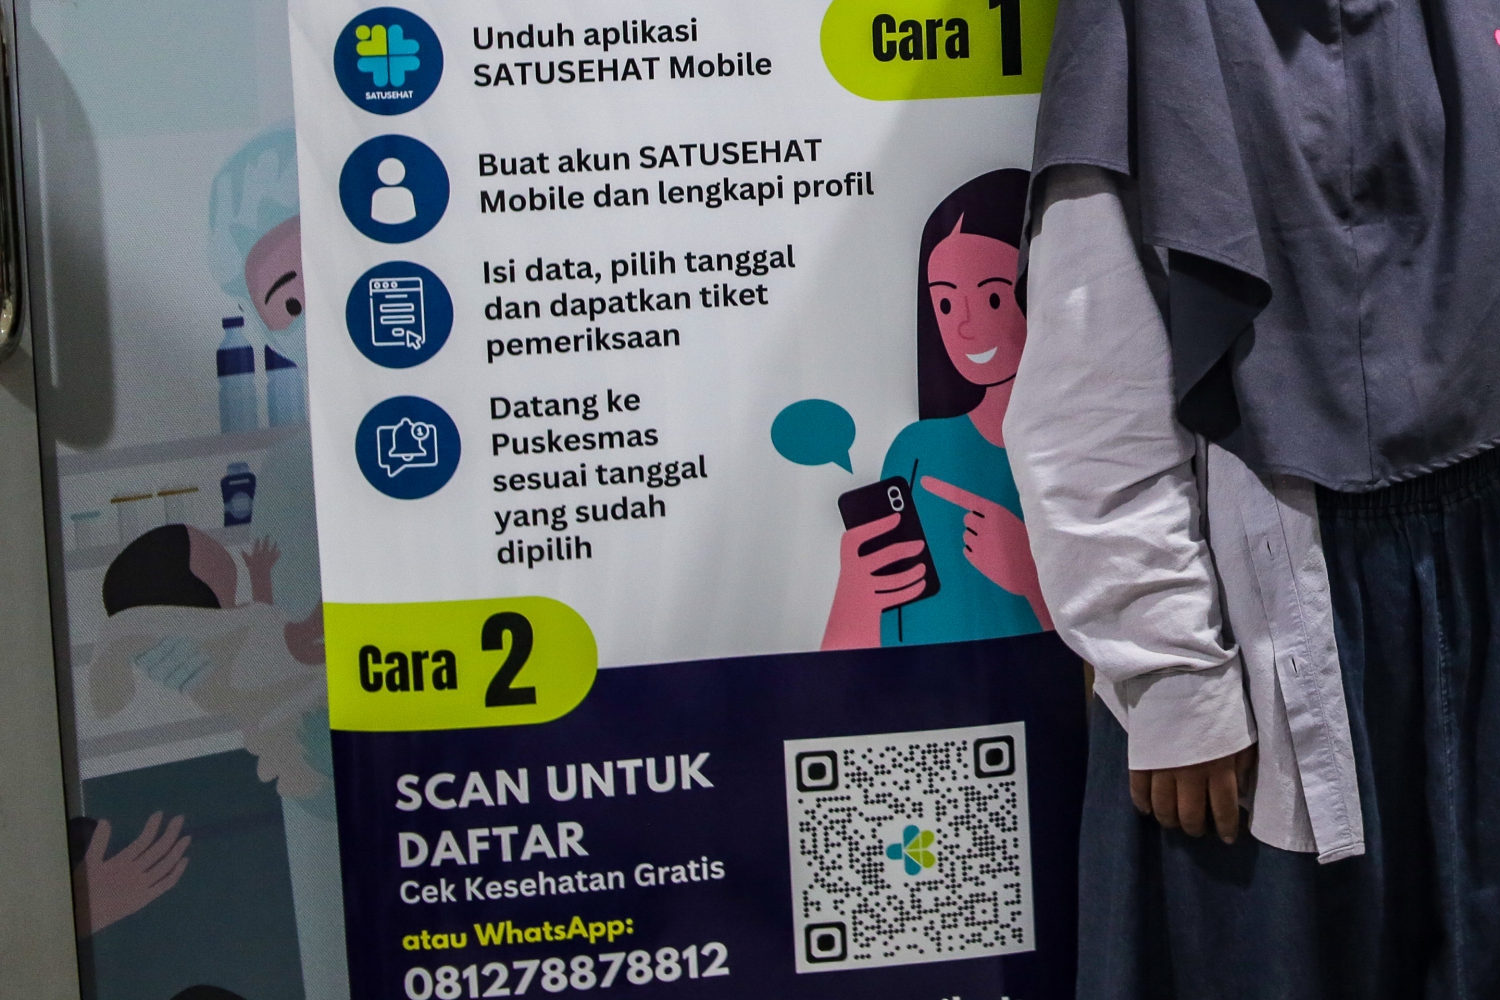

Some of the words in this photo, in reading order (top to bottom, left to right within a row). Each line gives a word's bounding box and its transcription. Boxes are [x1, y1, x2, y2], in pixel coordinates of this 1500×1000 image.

[473, 23, 575, 49] Unduh
[583, 17, 699, 53] aplikasi
[871, 13, 970, 62] Cara
[473, 56, 660, 87] SATUSEHAT
[670, 52, 772, 79] Mobile
[365, 90, 414, 100] SATUSEHAT
[478, 152, 549, 177] Buat
[558, 146, 630, 172] akun
[639, 139, 822, 169] SATUSEHAT
[480, 184, 584, 214] Mobile
[593, 179, 649, 208] dan
[659, 174, 785, 208] lengkapi
[793, 171, 874, 203] profil
[483, 260, 515, 285] Isi
[525, 255, 602, 283] data,
[611, 249, 676, 283] pilih
[684, 245, 795, 280] tanggal
[485, 292, 541, 321] dan
[550, 285, 691, 323] dapatkan
[700, 283, 768, 308] tiket
[487, 325, 680, 363] pemeriksaan
[490, 394, 599, 419] Datang
[608, 390, 640, 413] ke
[492, 426, 658, 456] Puskesmas
[493, 463, 587, 492] sesuai
[595, 455, 707, 489] tanggal
[495, 506, 568, 535] yang
[575, 495, 666, 524] sudah
[498, 535, 592, 569] dipilih
[358, 644, 458, 692] Cara
[481, 611, 536, 708] 2
[395, 768, 531, 812] SCAN
[547, 752, 714, 802] UNTUK
[398, 822, 590, 868] DAFTAR
[400, 881, 458, 905] Cek
[465, 867, 626, 900] Kesehatan
[634, 857, 725, 887] Gratis
[402, 929, 467, 951] atau
[474, 915, 634, 948] WhatsApp:
[404, 942, 730, 1000] 081278878812
